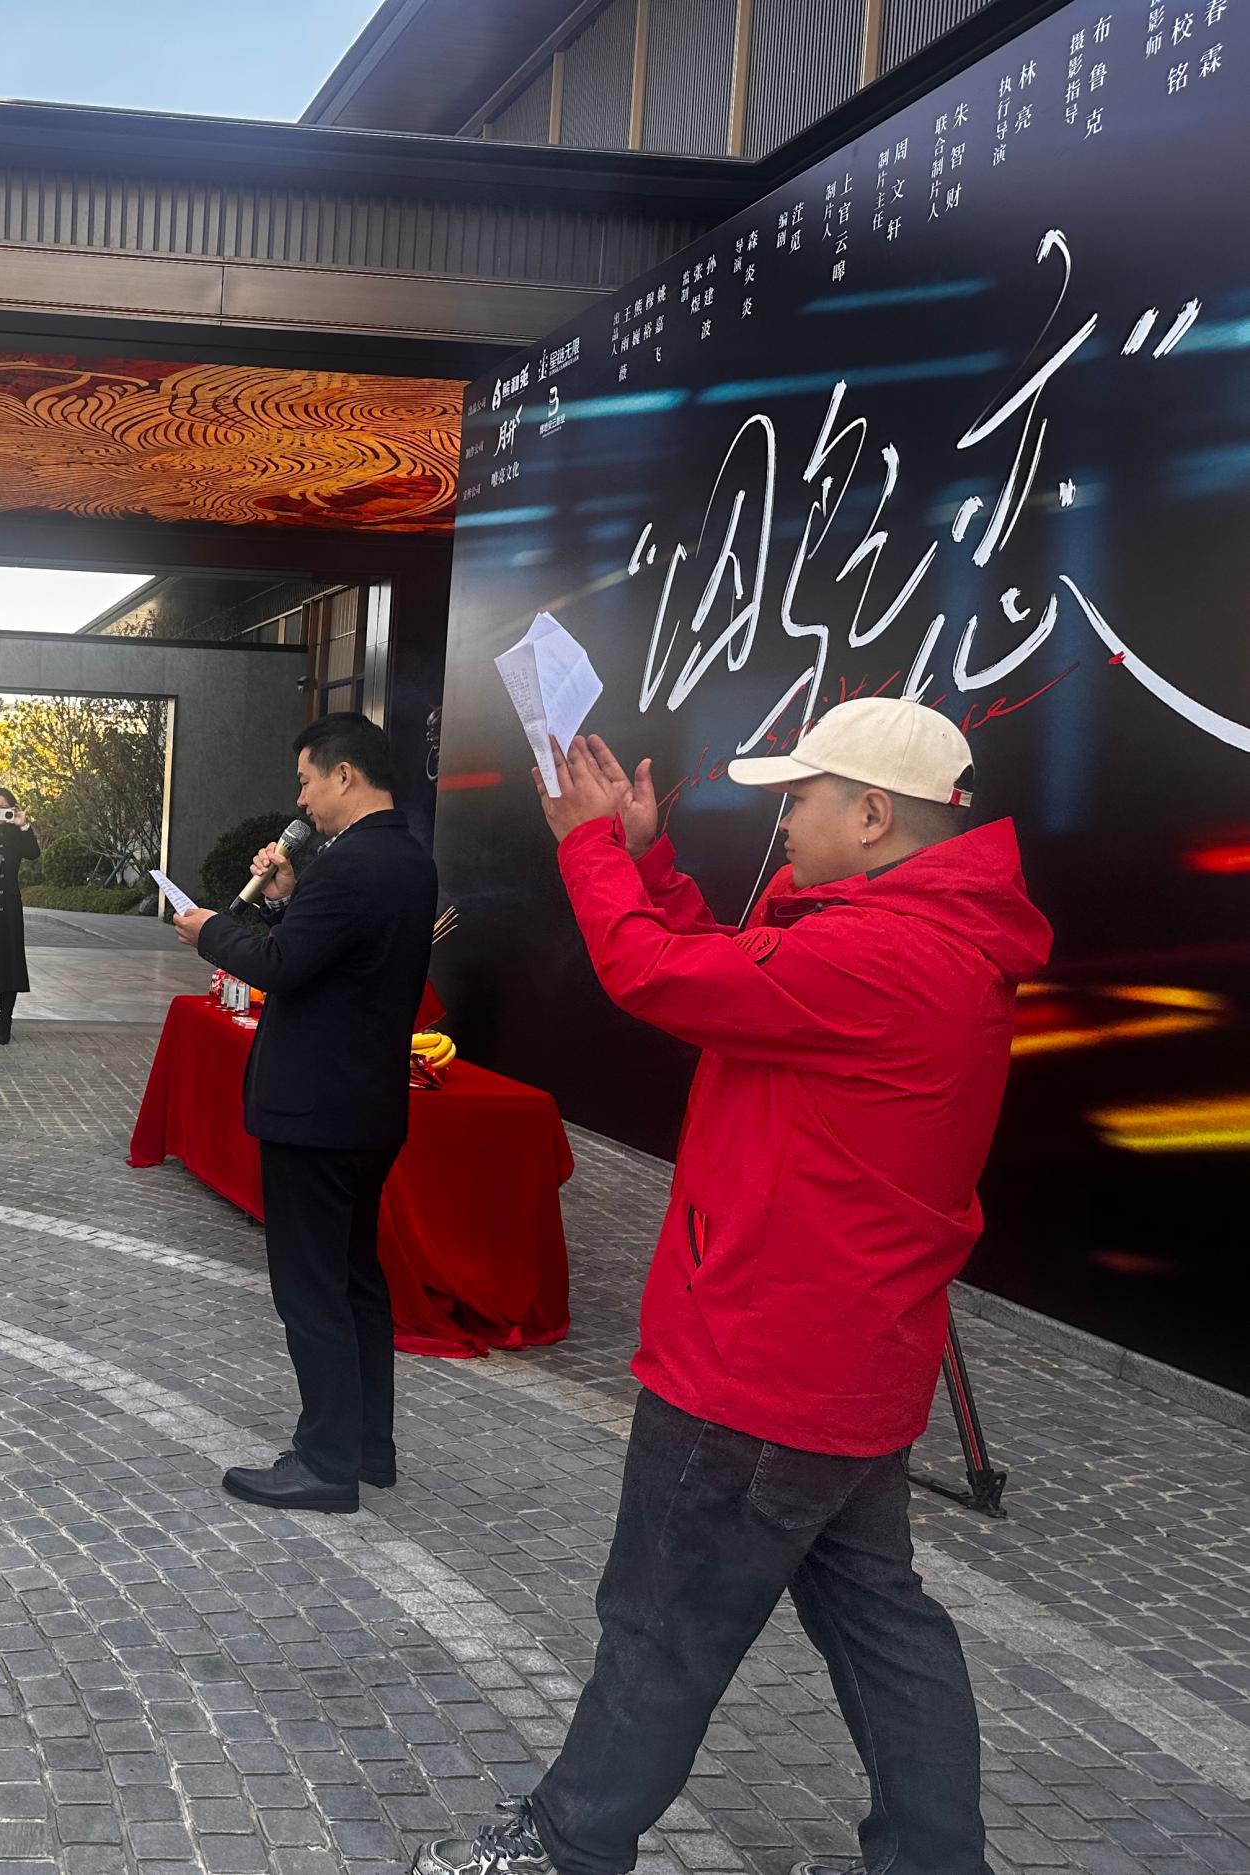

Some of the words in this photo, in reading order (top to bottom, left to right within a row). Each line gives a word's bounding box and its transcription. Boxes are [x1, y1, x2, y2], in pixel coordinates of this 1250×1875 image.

[1145, 0, 1165, 60] 影师
[1167, 12, 1194, 95] 校铭
[1014, 59, 1037, 134] 林亮
[1063, 28, 1086, 125] 摄影指导
[1083, 14, 1113, 140] 布鲁克
[945, 102, 969, 213] 朱智财
[992, 75, 1012, 167] 执行导演
[822, 180, 837, 241] 制片人
[872, 148, 890, 232] 制片主任
[886, 137, 909, 242] 周文轩
[927, 113, 947, 223] 联合制片人
[733, 237, 744, 274] 导演
[776, 211, 789, 249] 编剧
[700, 254, 717, 340] 孙建波
[741, 229, 759, 320] 森炎炎
